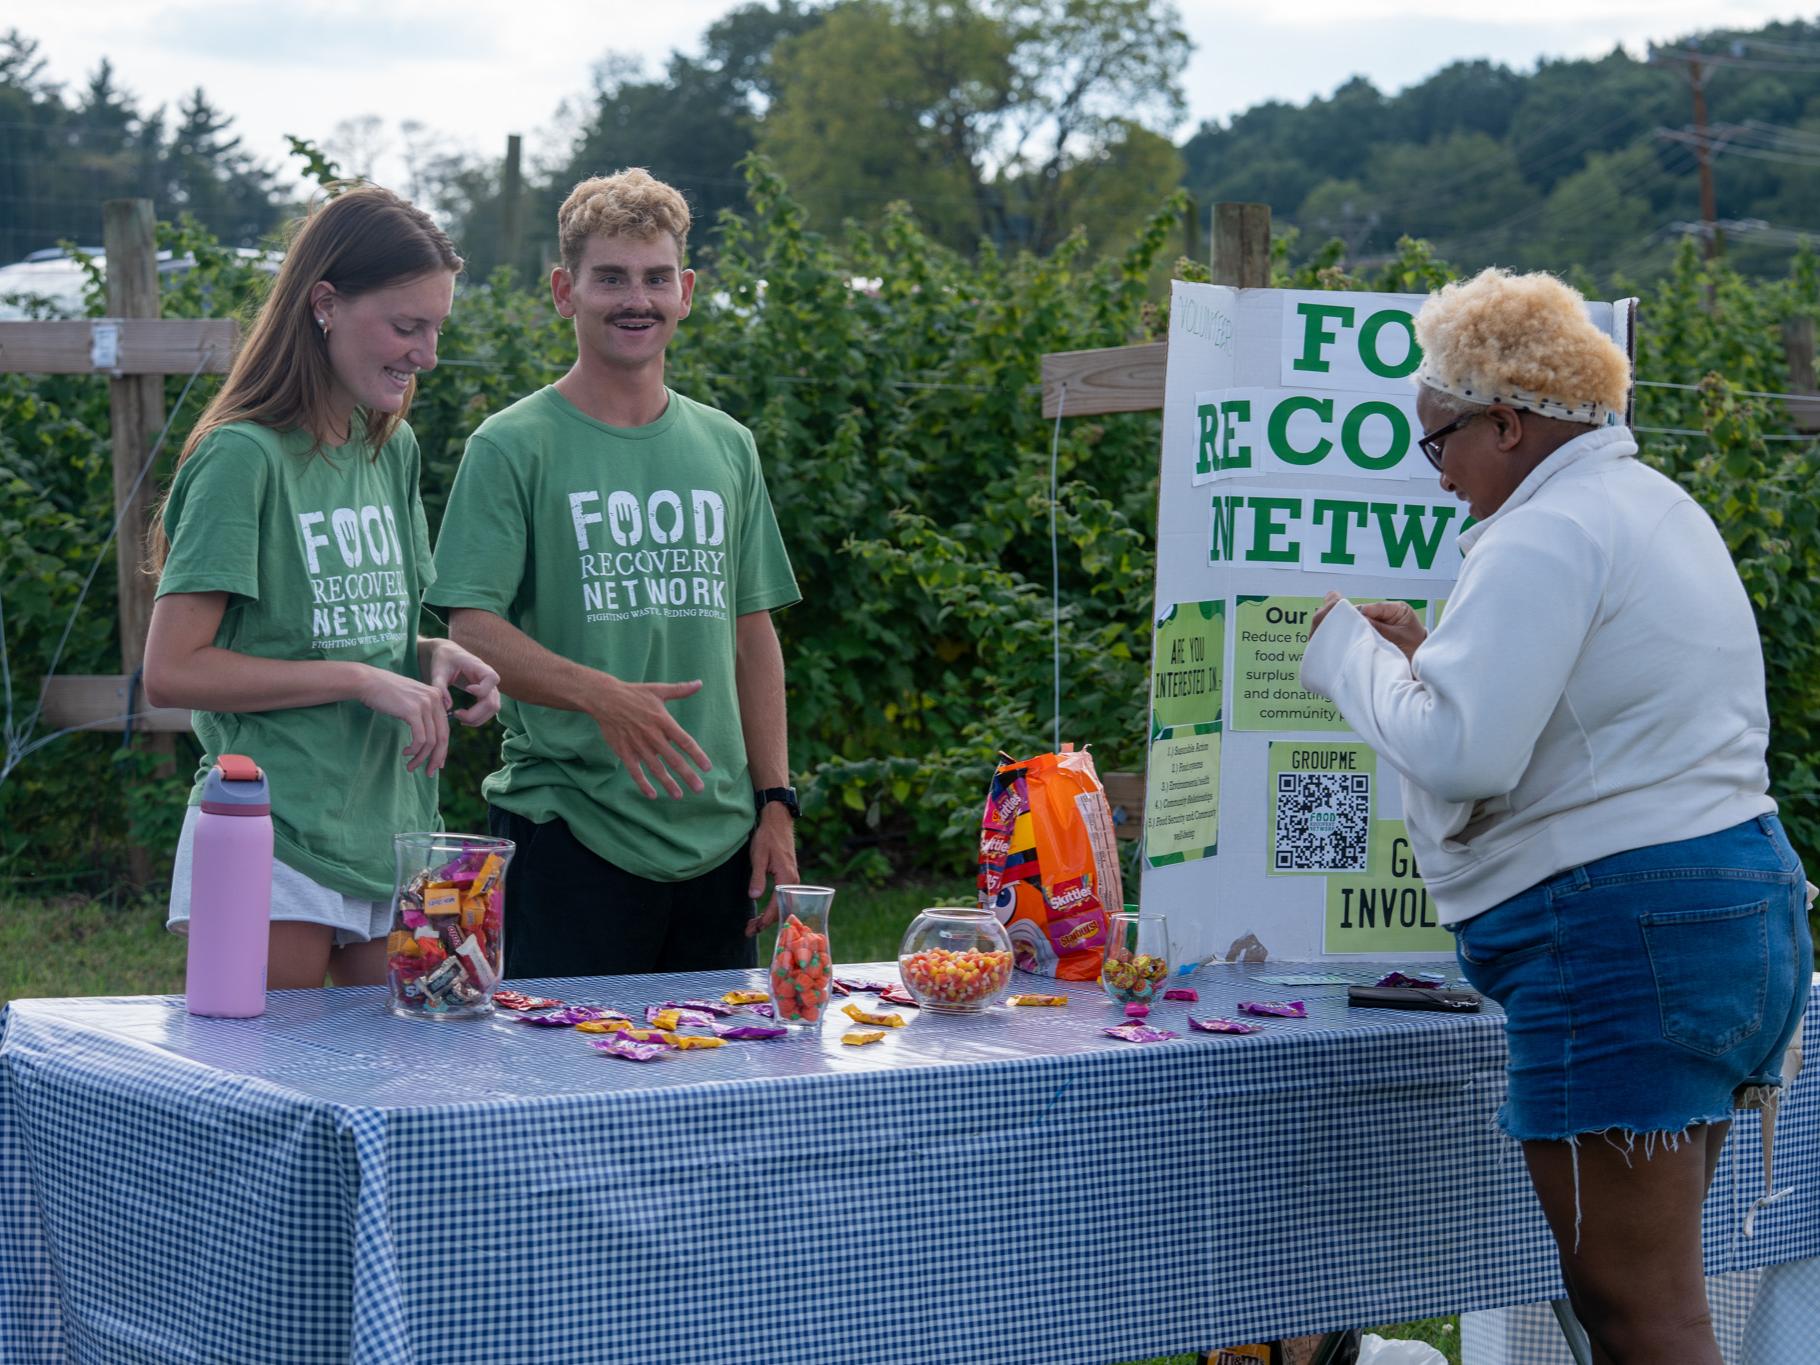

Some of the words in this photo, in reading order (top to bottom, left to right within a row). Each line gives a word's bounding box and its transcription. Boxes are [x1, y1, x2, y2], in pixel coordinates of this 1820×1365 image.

[1293, 303, 1424, 379] FO
[1196, 396, 1411, 475] RECO
[568, 490, 725, 551] FOOD
[1210, 496, 1480, 570] NETW
[579, 549, 726, 580] RECOVERY
[583, 577, 727, 611] NETWORK
[1266, 606, 1307, 625] Our
[312, 638, 357, 649] FIGHTING
[1189, 636, 1205, 662] YOU
[1242, 631, 1292, 643] Reduce
[1296, 632, 1310, 643] fo
[1255, 650, 1285, 661] food
[1155, 669, 1205, 699] INTERESTED
[1246, 670, 1295, 683] surplus
[1244, 689, 1269, 699] and
[1260, 708, 1336, 722] community
[1292, 750, 1357, 770] GROUPME
[1050, 887, 1092, 911] Skittles
[1340, 888, 1436, 928] INVOL
